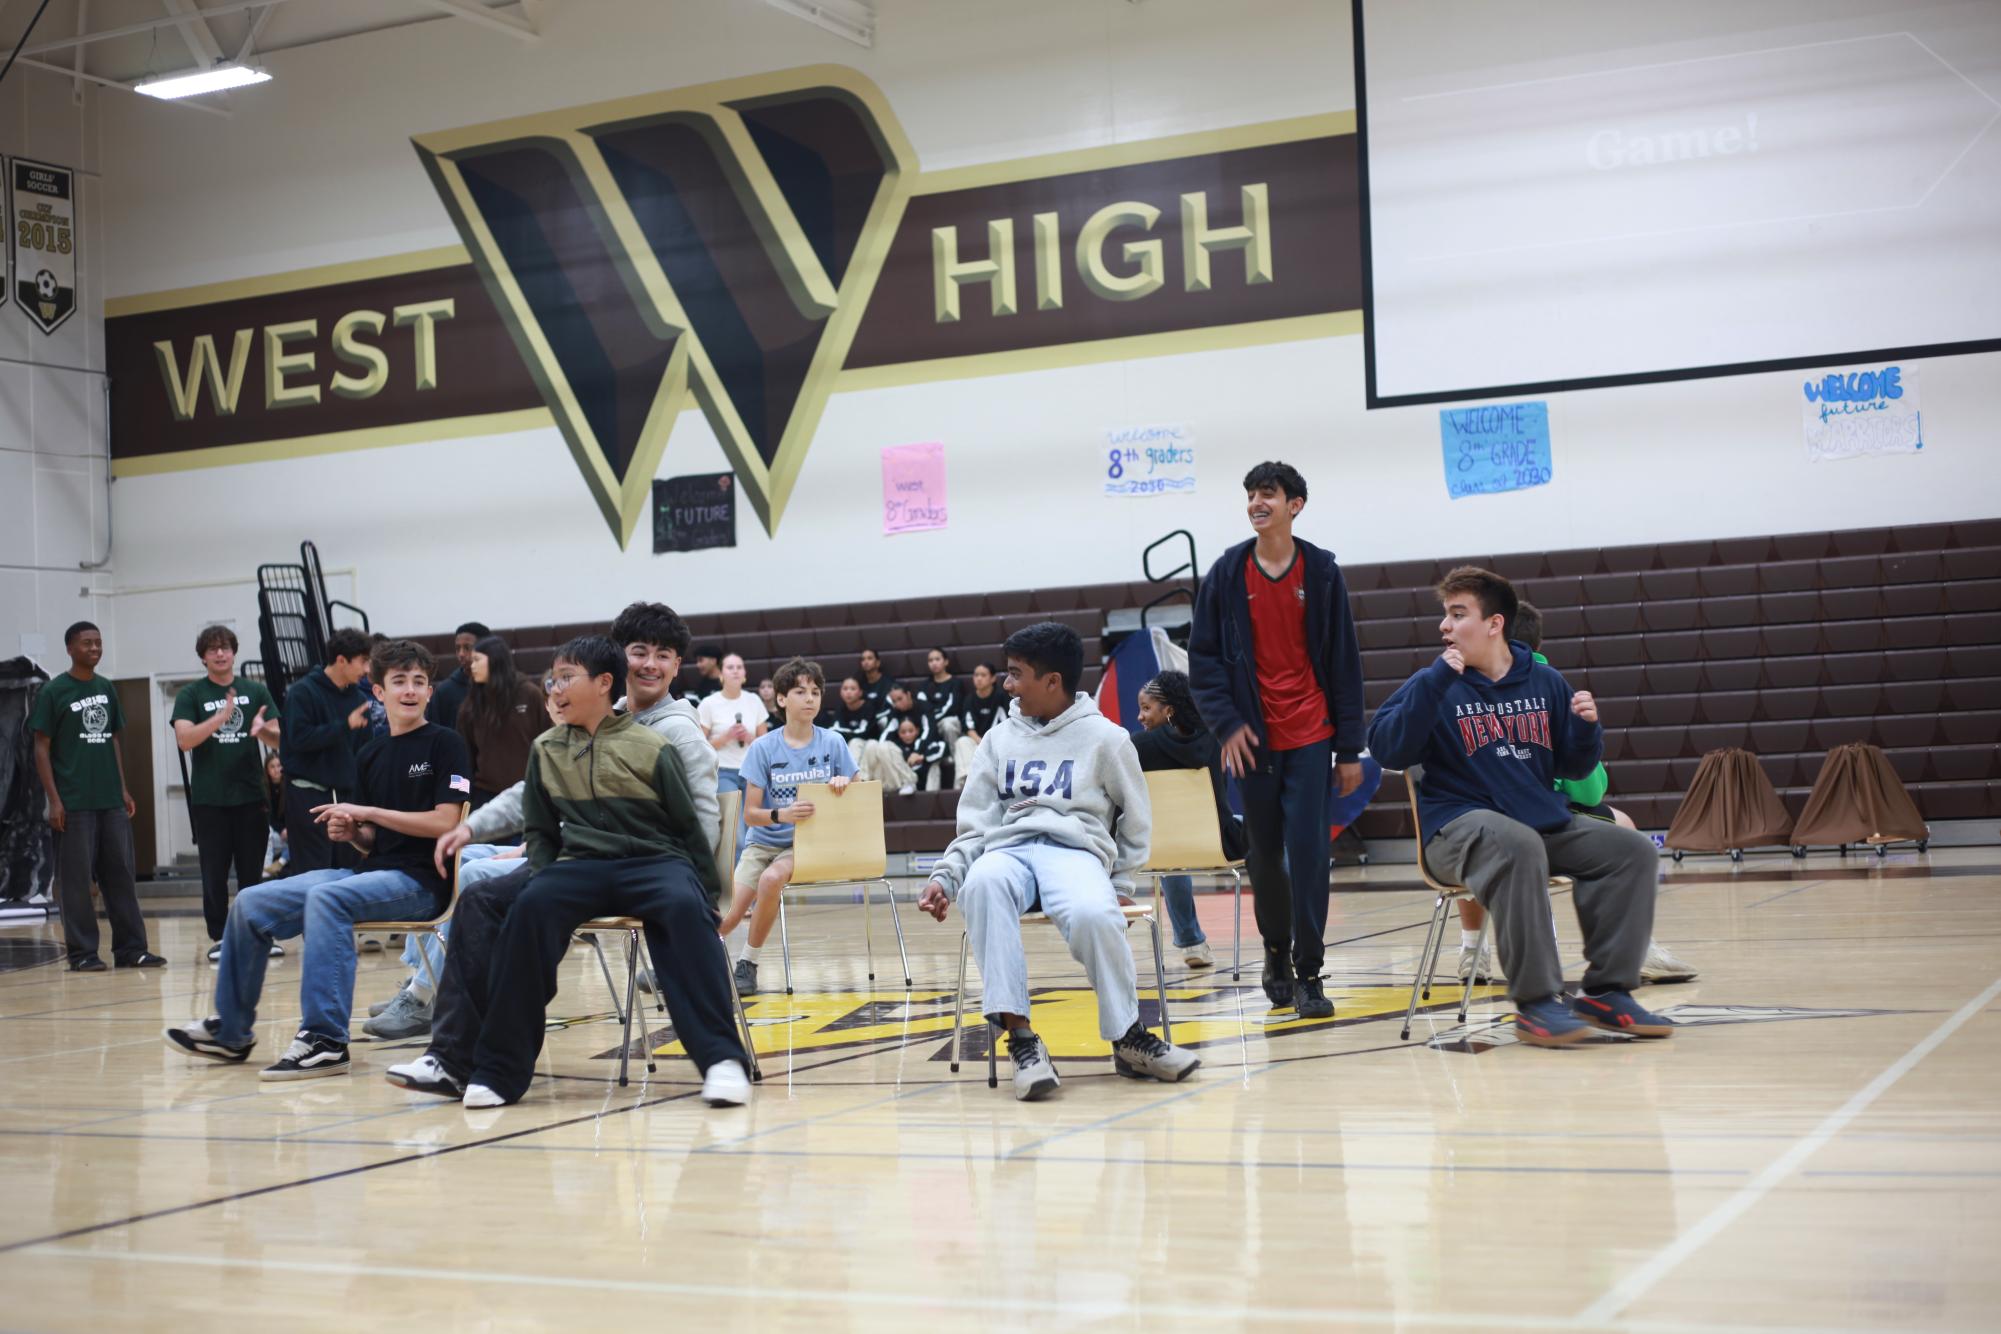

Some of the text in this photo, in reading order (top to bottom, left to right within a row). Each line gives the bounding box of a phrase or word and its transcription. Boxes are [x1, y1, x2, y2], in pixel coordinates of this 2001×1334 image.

[1586, 112, 1759, 170] Game!
[26, 180, 58, 194] SOCCER
[18, 220, 72, 255] 2015
[154, 299, 455, 421] WEST
[932, 183, 1273, 324] HIGH
[1802, 366, 1904, 403] WELCOME
[1449, 405, 1525, 434] WELCOME
[1819, 400, 1890, 424] future
[1108, 440, 1194, 480] 8th graders
[1490, 438, 1537, 467] GRADE
[1513, 466, 1552, 486] 2030
[674, 503, 730, 527] FUTURE
[1456, 697, 1546, 717] AERPOSTAL
[1458, 710, 1554, 757] NEW YORK
[996, 759, 1074, 800] USA
